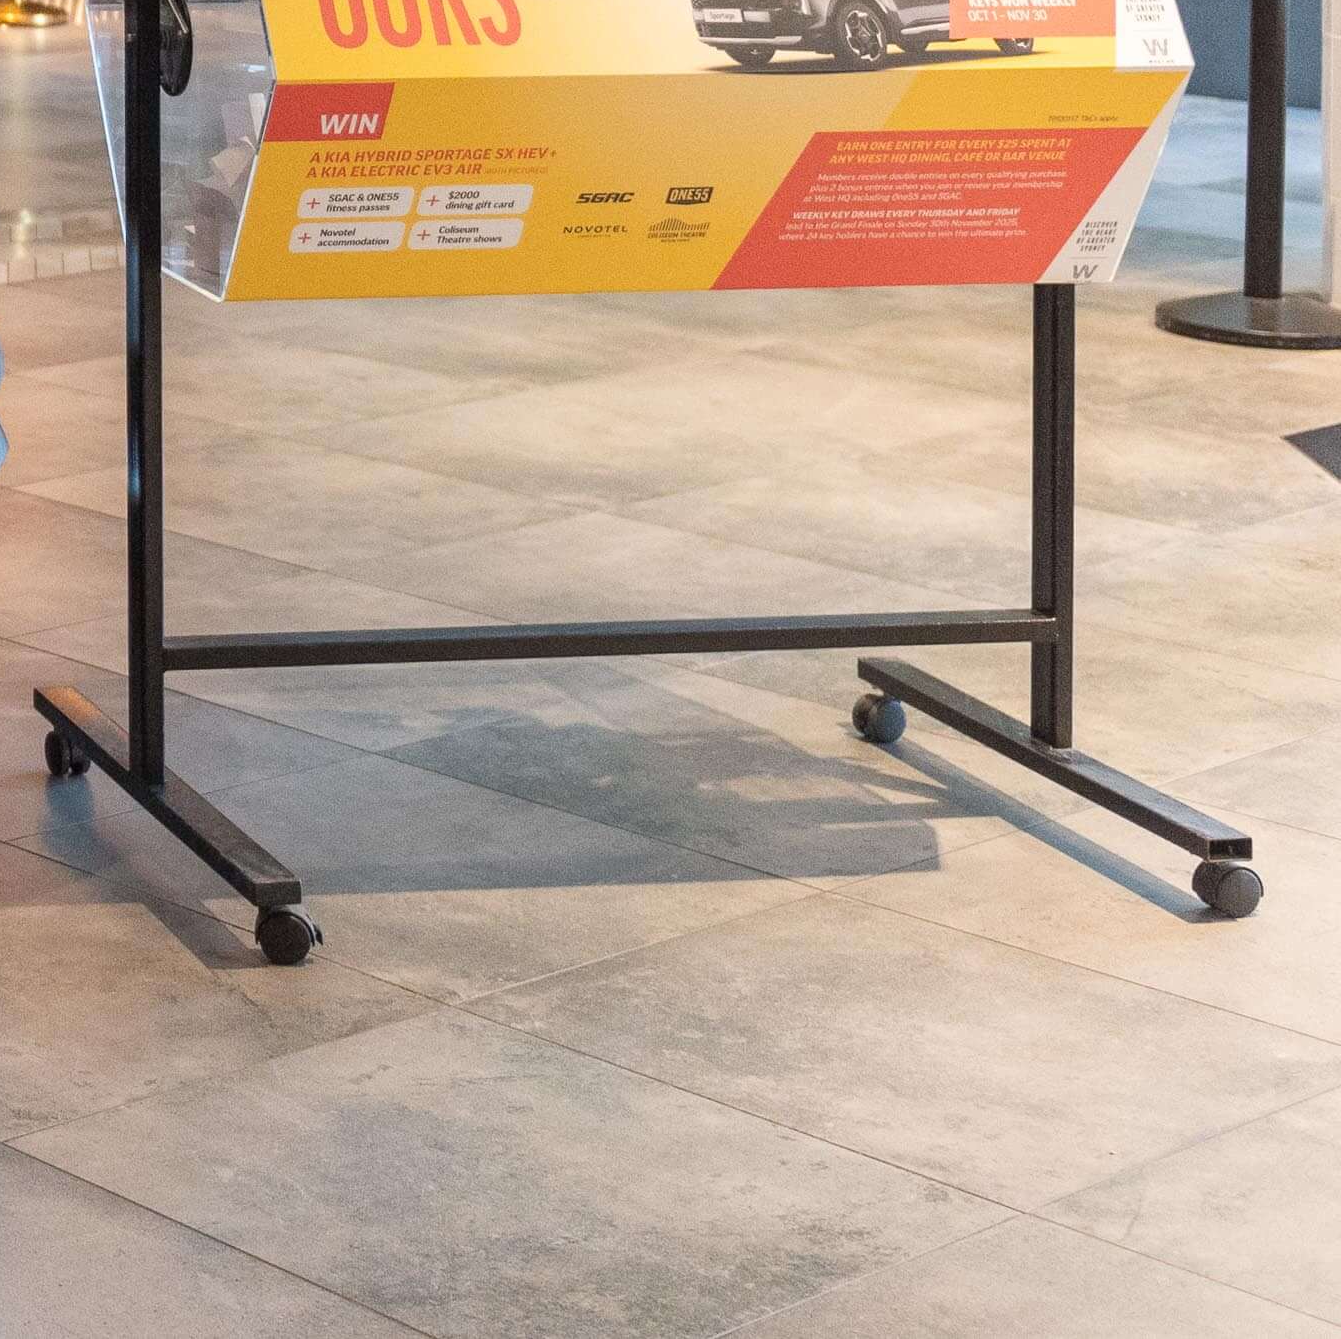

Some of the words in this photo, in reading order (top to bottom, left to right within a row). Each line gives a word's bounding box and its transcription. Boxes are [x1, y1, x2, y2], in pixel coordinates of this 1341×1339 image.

[968, 10, 989, 21] OCT
[1007, 9, 1030, 21] NOV
[1031, 9, 1047, 21] 30
[320, 114, 379, 134] WIN
[837, 141, 868, 151] EARN
[869, 141, 895, 151] ONE
[895, 140, 932, 151] ENTRY
[934, 140, 957, 150] FOR
[958, 139, 996, 150] EVERY
[1020, 138, 1058, 149] SPENT
[1058, 138, 1072, 148] AT
[310, 152, 320, 163] A
[324, 151, 350, 163] KIA
[354, 150, 412, 162] HYBRID
[416, 148, 491, 161] SPORTAGE
[496, 148, 514, 159] SX
[517, 147, 549, 159] HEV
[829, 153, 856, 163] ANY
[857, 153, 889, 163] WEST
[889, 152, 907, 163] HQ
[984, 151, 1002, 161] OR
[1002, 151, 1028, 161] BAR
[1028, 150, 1067, 160] VENUE
[307, 168, 317, 179] A
[321, 167, 347, 178] KIA
[350, 165, 421, 177] ELECTRIC
[423, 164, 452, 176] EV3
[455, 164, 483, 175] AIR
[328, 193, 356, 202] SGAC
[366, 192, 399, 201] ONE55
[448, 191, 479, 199] $2000
[576, 192, 635, 203] SGAC
[669, 187, 710, 202] ONE55
[326, 204, 357, 212] fitness
[358, 204, 390, 212] passes
[445, 202, 473, 210] dining
[475, 201, 491, 210] gift
[494, 200, 514, 208] card
[793, 211, 830, 219] WEEKLY
[831, 211, 850, 219] KEY
[851, 210, 884, 218] DRAWS
[885, 210, 917, 218] EVERY
[918, 209, 965, 217] THURSDAY
[966, 208, 986, 216] AND
[320, 228, 356, 237] Novotel
[438, 225, 479, 234] Coliseum
[563, 224, 628, 234] NOVOTEL
[317, 238, 389, 247] accommodation
[437, 235, 471, 243] Theatre
[473, 235, 502, 243] shows
